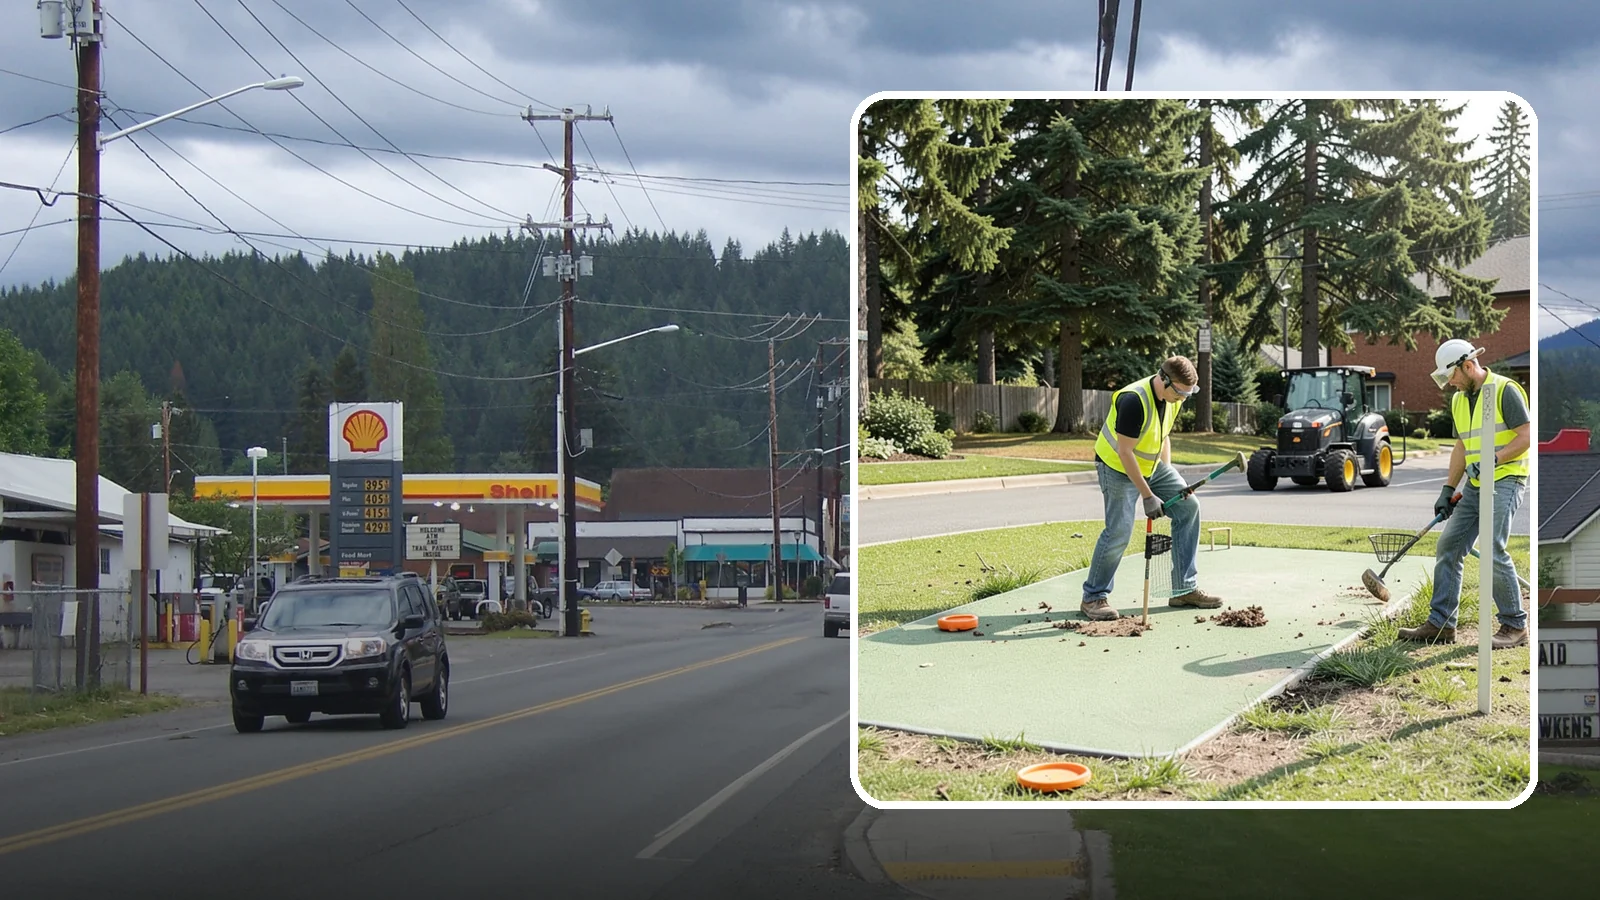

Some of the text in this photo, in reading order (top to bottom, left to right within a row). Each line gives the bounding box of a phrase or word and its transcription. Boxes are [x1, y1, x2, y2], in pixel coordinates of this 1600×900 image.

[366, 480, 384, 490] 395
[490, 484, 547, 499] Shell
[366, 494, 384, 504] 405
[366, 508, 384, 518] 415
[366, 522, 384, 532] 429
[1538, 643, 1566, 665] AID
[1538, 716, 1592, 738] WKENS
